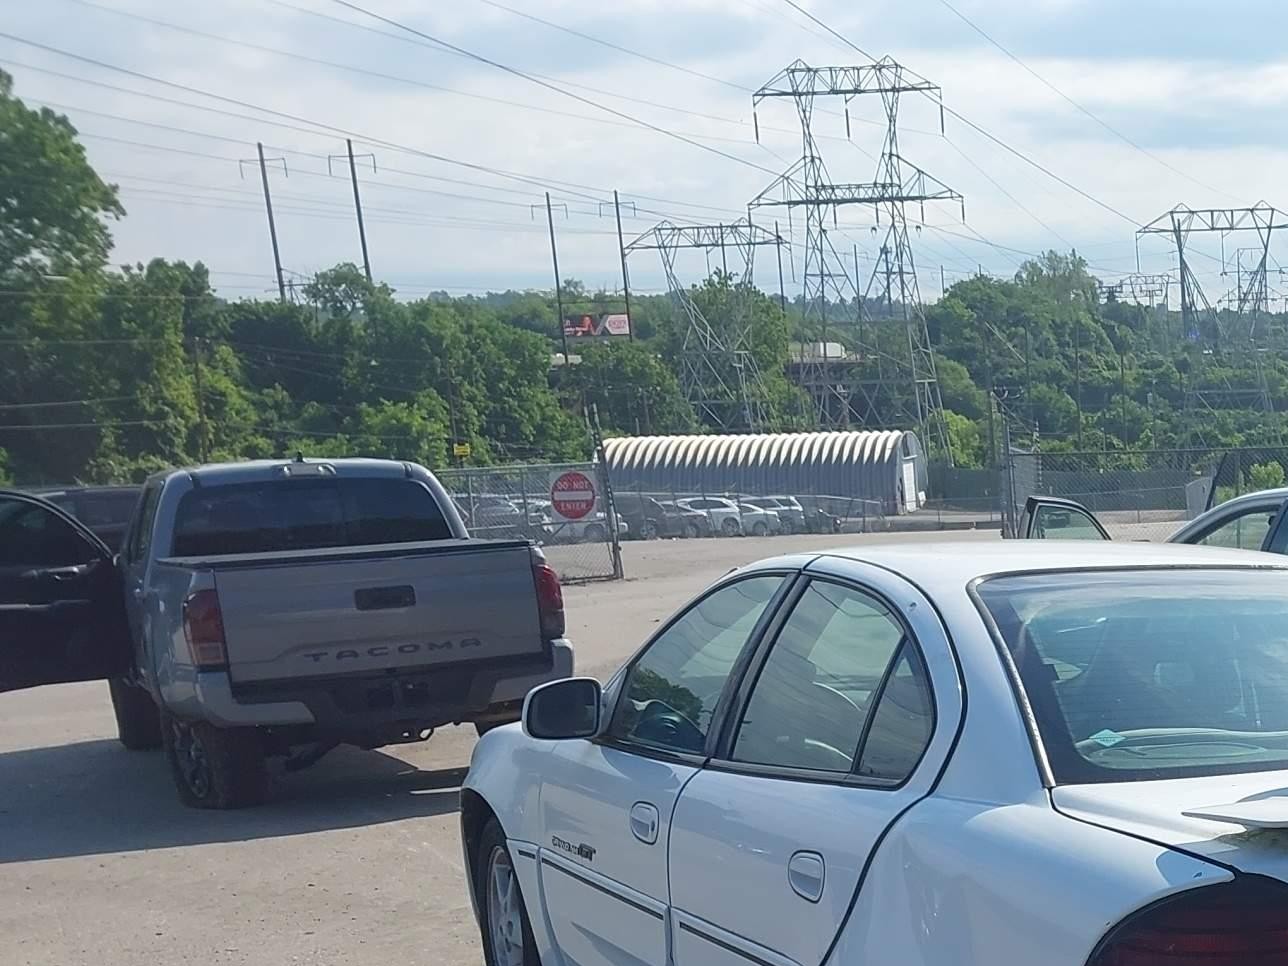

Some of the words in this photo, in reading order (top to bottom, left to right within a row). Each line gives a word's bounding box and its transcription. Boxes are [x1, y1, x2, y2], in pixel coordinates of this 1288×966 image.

[572, 480, 589, 489] NOT
[560, 501, 587, 511] ENTER
[303, 638, 482, 662] TACOMA
